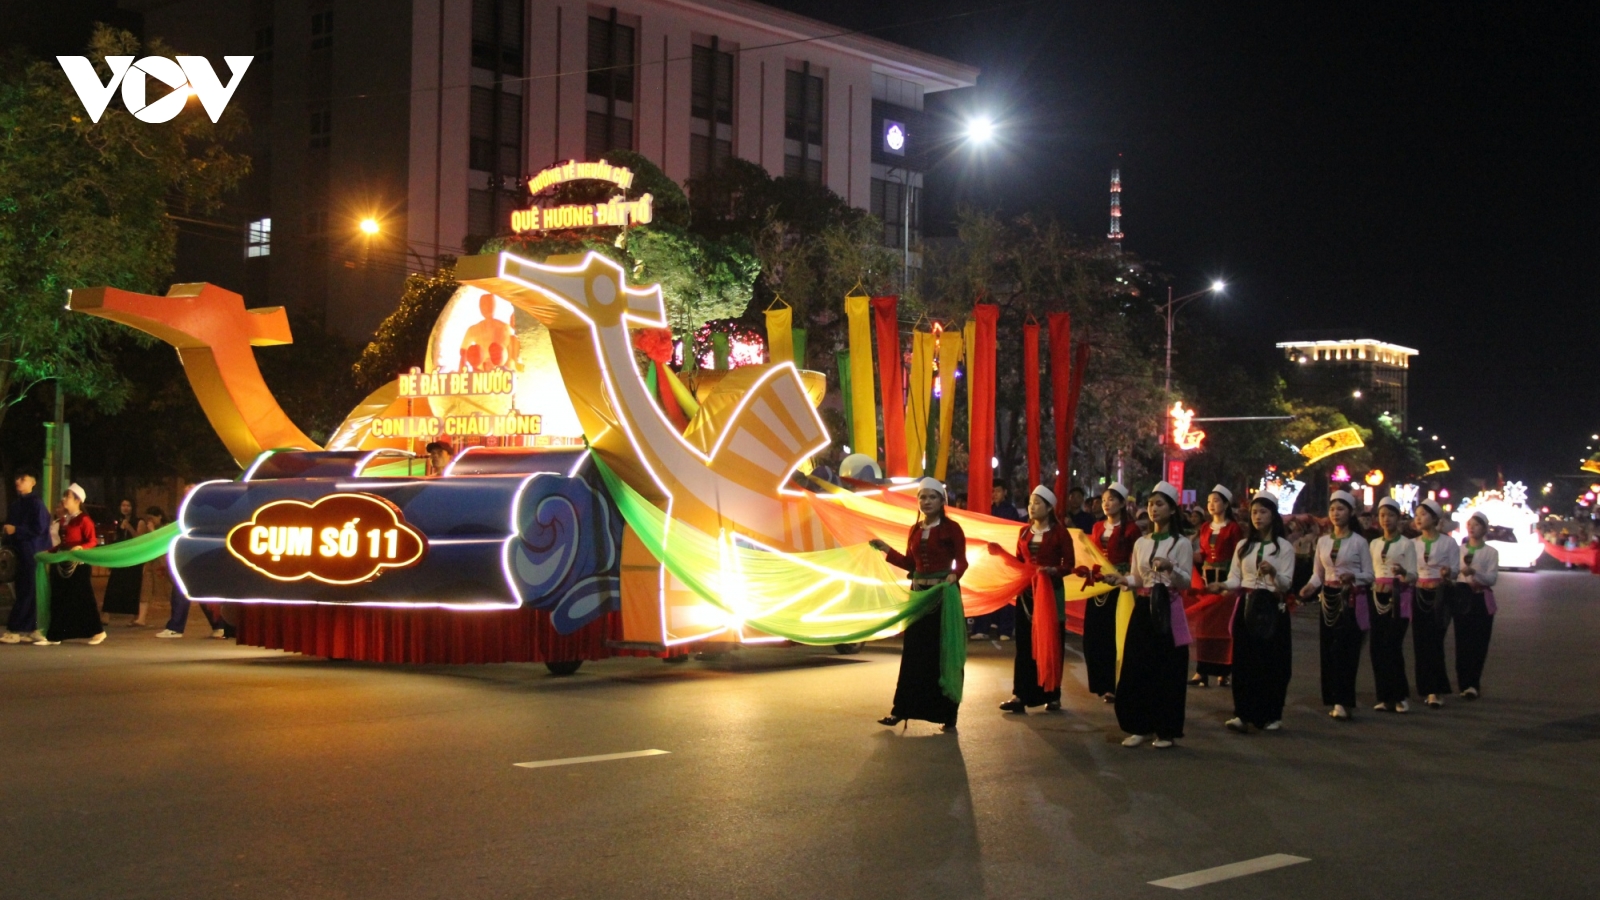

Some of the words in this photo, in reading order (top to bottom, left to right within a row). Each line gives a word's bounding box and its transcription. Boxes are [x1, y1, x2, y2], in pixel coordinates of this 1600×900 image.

[529, 168, 562, 195] HƯỚNG
[562, 159, 576, 180] VỀ
[511, 206, 540, 233] QUÊ
[543, 205, 594, 230] HƯƠNG
[597, 195, 626, 225] ĐẤT
[629, 193, 653, 224] TỔ
[399, 368, 417, 396] ĐẺ
[420, 367, 447, 396] ĐẤT
[451, 367, 469, 395] ĐẺ
[472, 366, 512, 395] NƯỚC
[372, 417, 404, 436] CON
[408, 417, 439, 439] LẠC
[445, 412, 490, 436] CHÁU
[494, 410, 542, 436] HỒNG
[250, 525, 313, 561] CỤM
[319, 517, 360, 557] SỐ
[367, 528, 398, 559] 11
